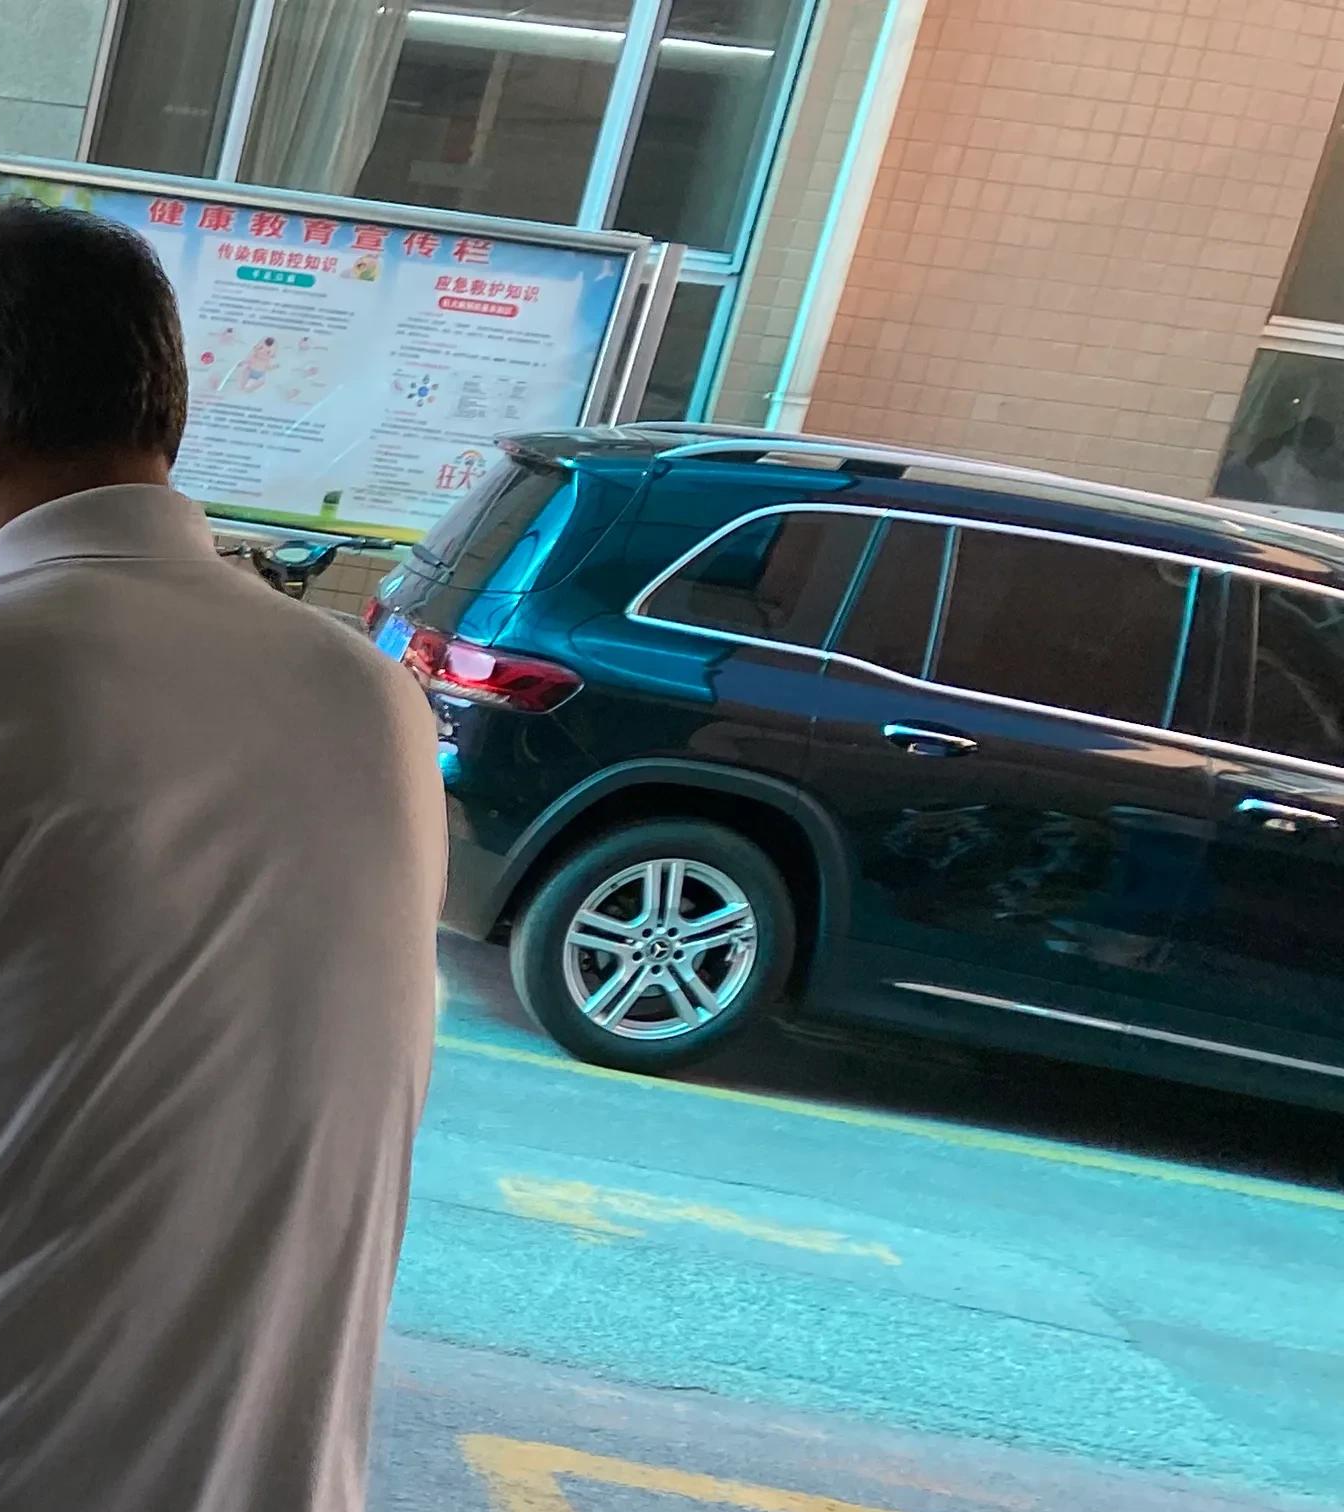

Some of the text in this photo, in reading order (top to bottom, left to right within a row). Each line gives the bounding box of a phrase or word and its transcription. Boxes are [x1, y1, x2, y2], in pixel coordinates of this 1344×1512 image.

[148, 198, 495, 265] 健康教育宣传栏
[218, 242, 338, 274] 传染病防控知识
[434, 275, 540, 302] 应急救护知识
[435, 463, 486, 490] 狂犬
